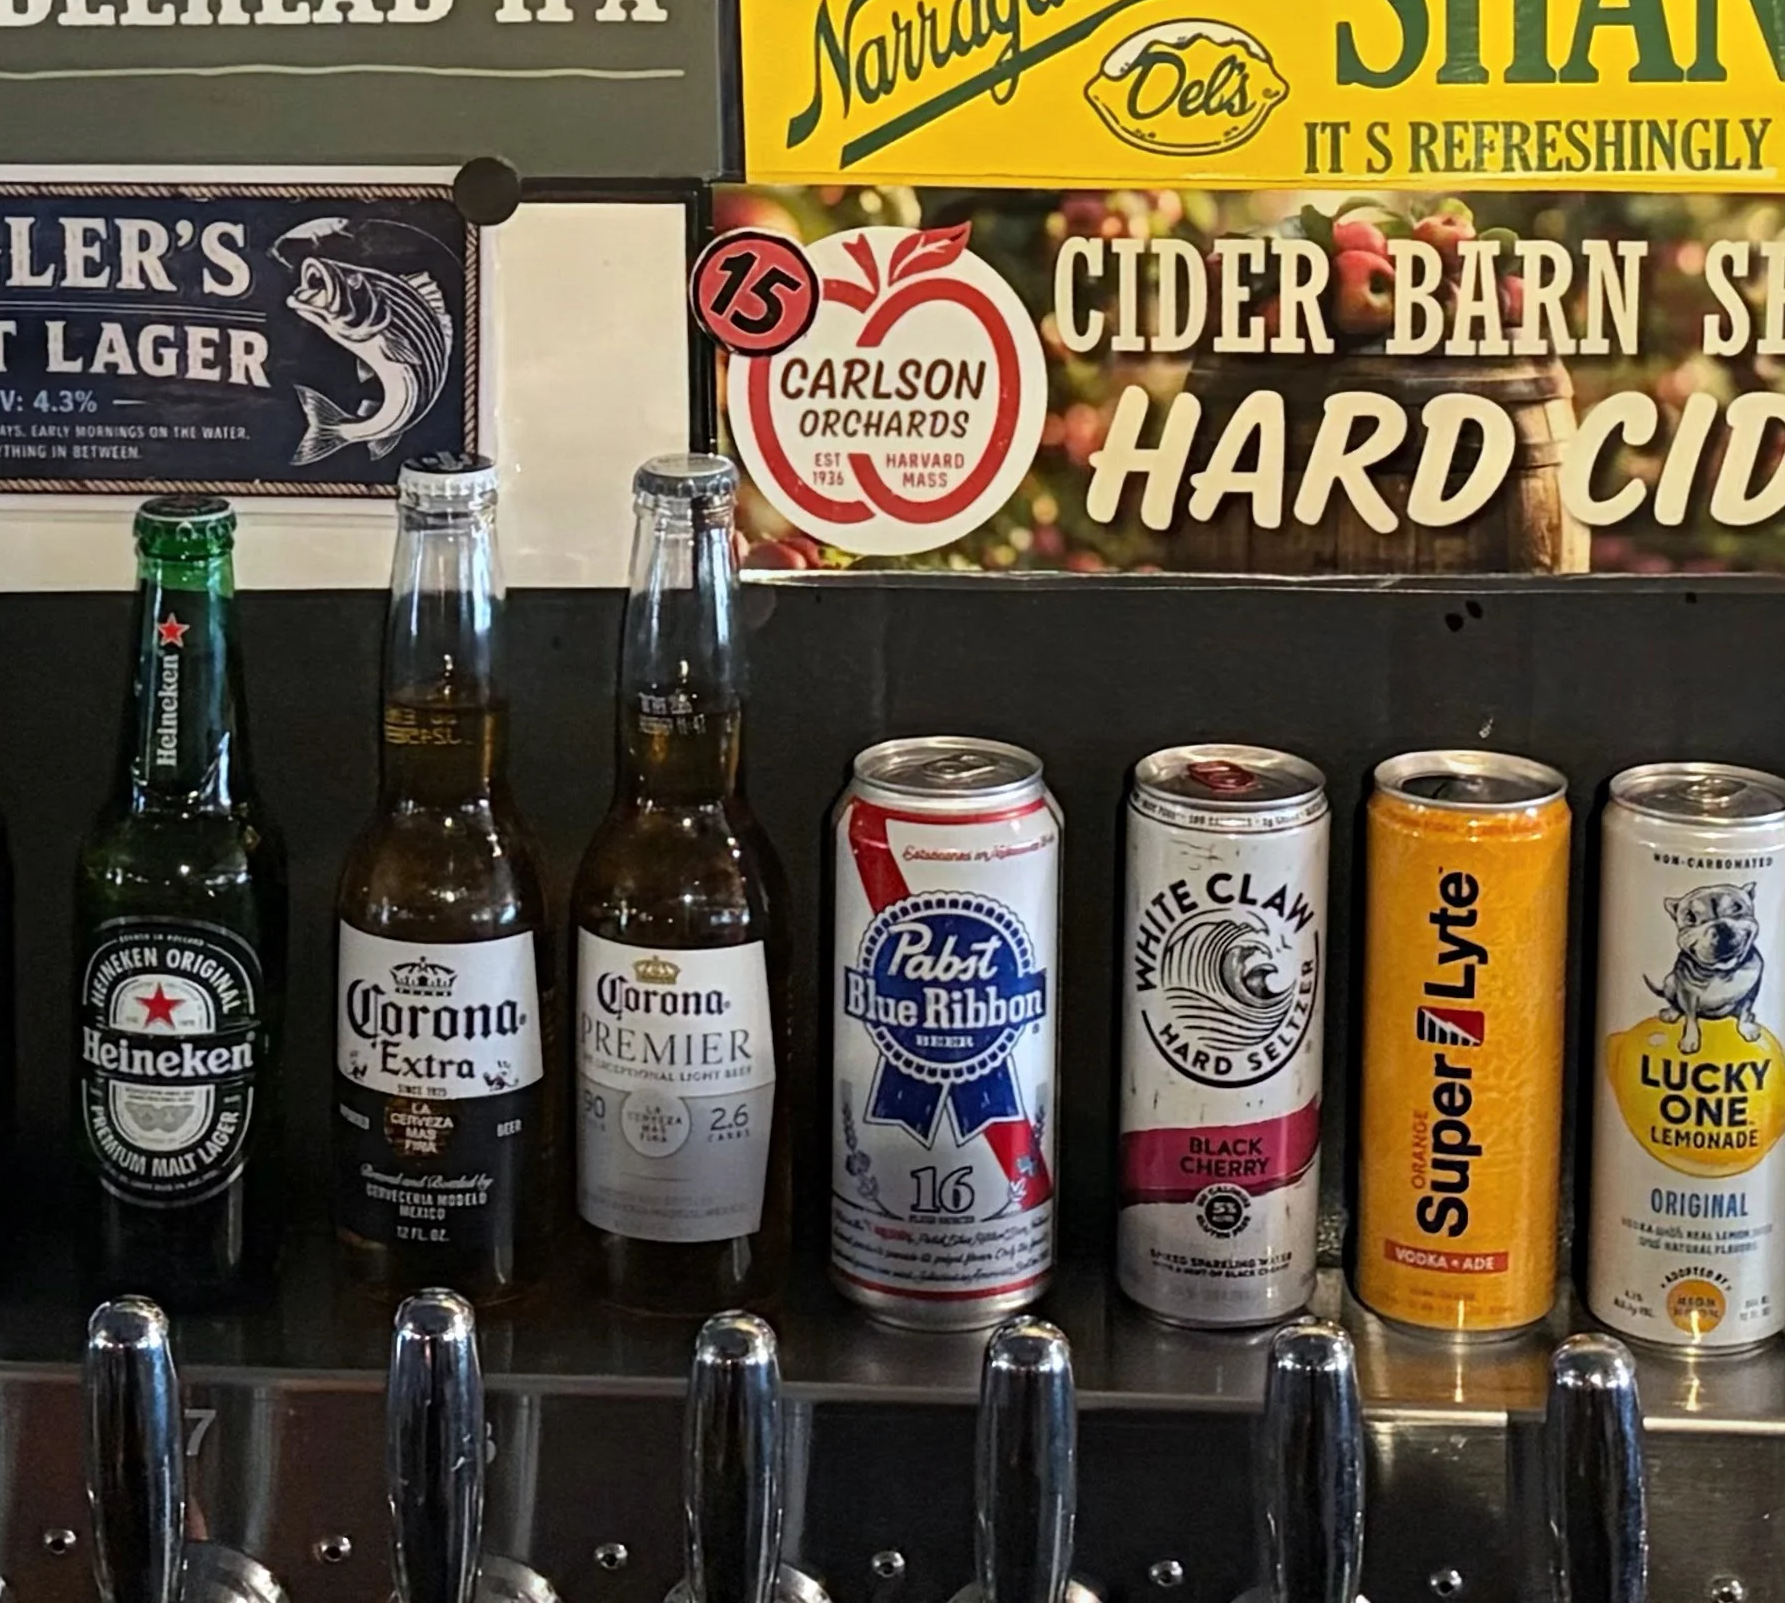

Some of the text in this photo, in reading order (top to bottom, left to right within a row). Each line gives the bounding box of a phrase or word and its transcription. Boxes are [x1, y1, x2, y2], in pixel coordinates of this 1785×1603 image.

[1406, 117, 1773, 172] REFRESHINGLY
[712, 249, 801, 338] 15
[1054, 235, 1334, 356] CIDER
[1389, 235, 1644, 356] BARN
[48, 321, 271, 386] LAGER
[781, 356, 986, 402] CARLSON
[33, 391, 97, 415] 4.3%
[799, 406, 972, 443] ORCHARDS
[884, 452, 965, 470] HARVARD
[900, 470, 949, 488] MASS
[1087, 383, 1519, 534] HARD
[887, 922, 1001, 980] Pabst
[1137, 873, 1314, 992] WHITE CLAW
[1423, 871, 1489, 1000] Lyte
[346, 978, 521, 1040] Corona
[597, 972, 725, 1024] Corona
[847, 973, 1044, 1029] Blue Ribbon
[1159, 958, 1316, 1075] HARD SELTZER
[83, 1026, 254, 1078] Heineken
[380, 1041, 475, 1080] Extra
[581, 1024, 752, 1065] PREMIER
[1640, 1054, 1772, 1093] LUCKY
[1659, 1092, 1748, 1126] ONE
[1189, 1136, 1263, 1157] BLACK
[1416, 1053, 1474, 1237] Super
[1651, 1128, 1759, 1150] LEMONADE
[1180, 1156, 1268, 1176] CHERRY
[1651, 1188, 1748, 1218] ORIGINAL
